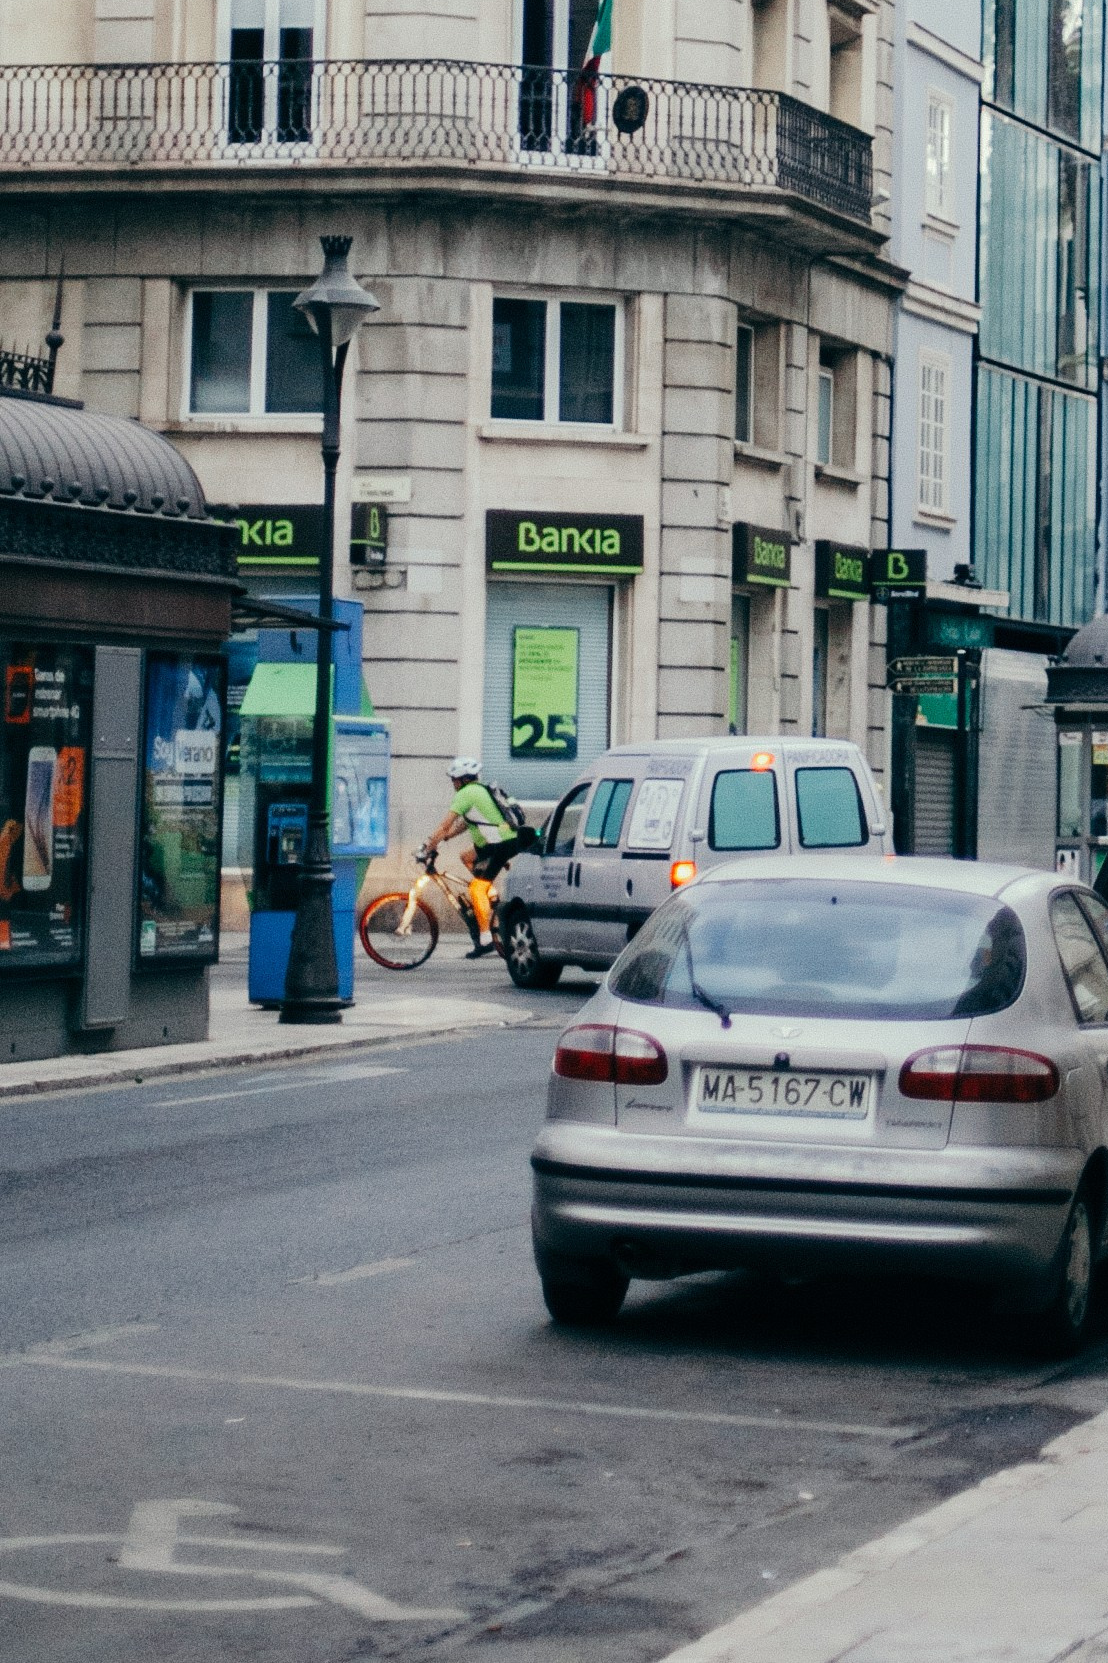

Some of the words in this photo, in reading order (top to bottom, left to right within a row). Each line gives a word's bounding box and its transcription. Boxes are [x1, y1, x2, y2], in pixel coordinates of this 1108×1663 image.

[518, 521, 622, 555] Bankia
[754, 536, 786, 570] Bankia
[835, 552, 864, 584] Bankia
[887, 552, 909, 580] B
[512, 714, 578, 759] 25
[701, 1074, 867, 1108] MA-5167-CW
